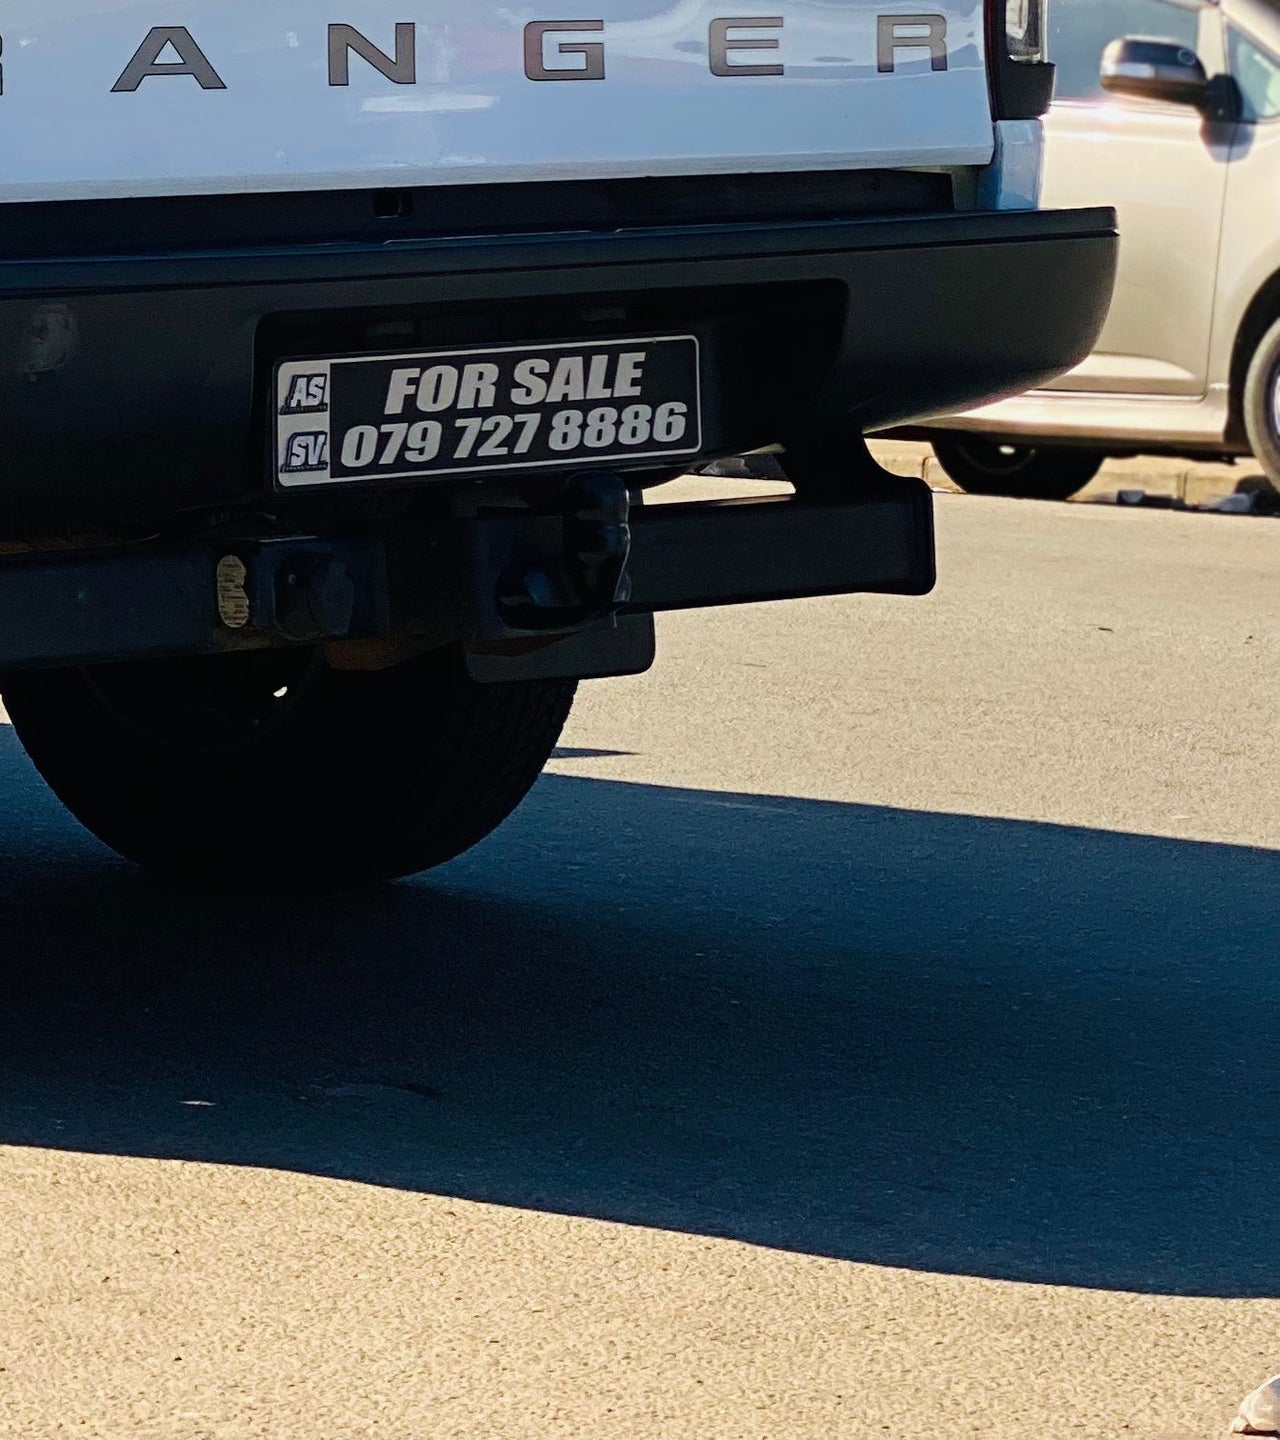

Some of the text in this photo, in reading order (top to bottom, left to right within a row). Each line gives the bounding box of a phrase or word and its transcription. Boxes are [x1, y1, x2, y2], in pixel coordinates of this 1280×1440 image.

[288, 375, 326, 408] AS
[384, 352, 646, 415] FOR SALE
[289, 432, 326, 467] SV
[340, 401, 688, 467] 079 727 8886
